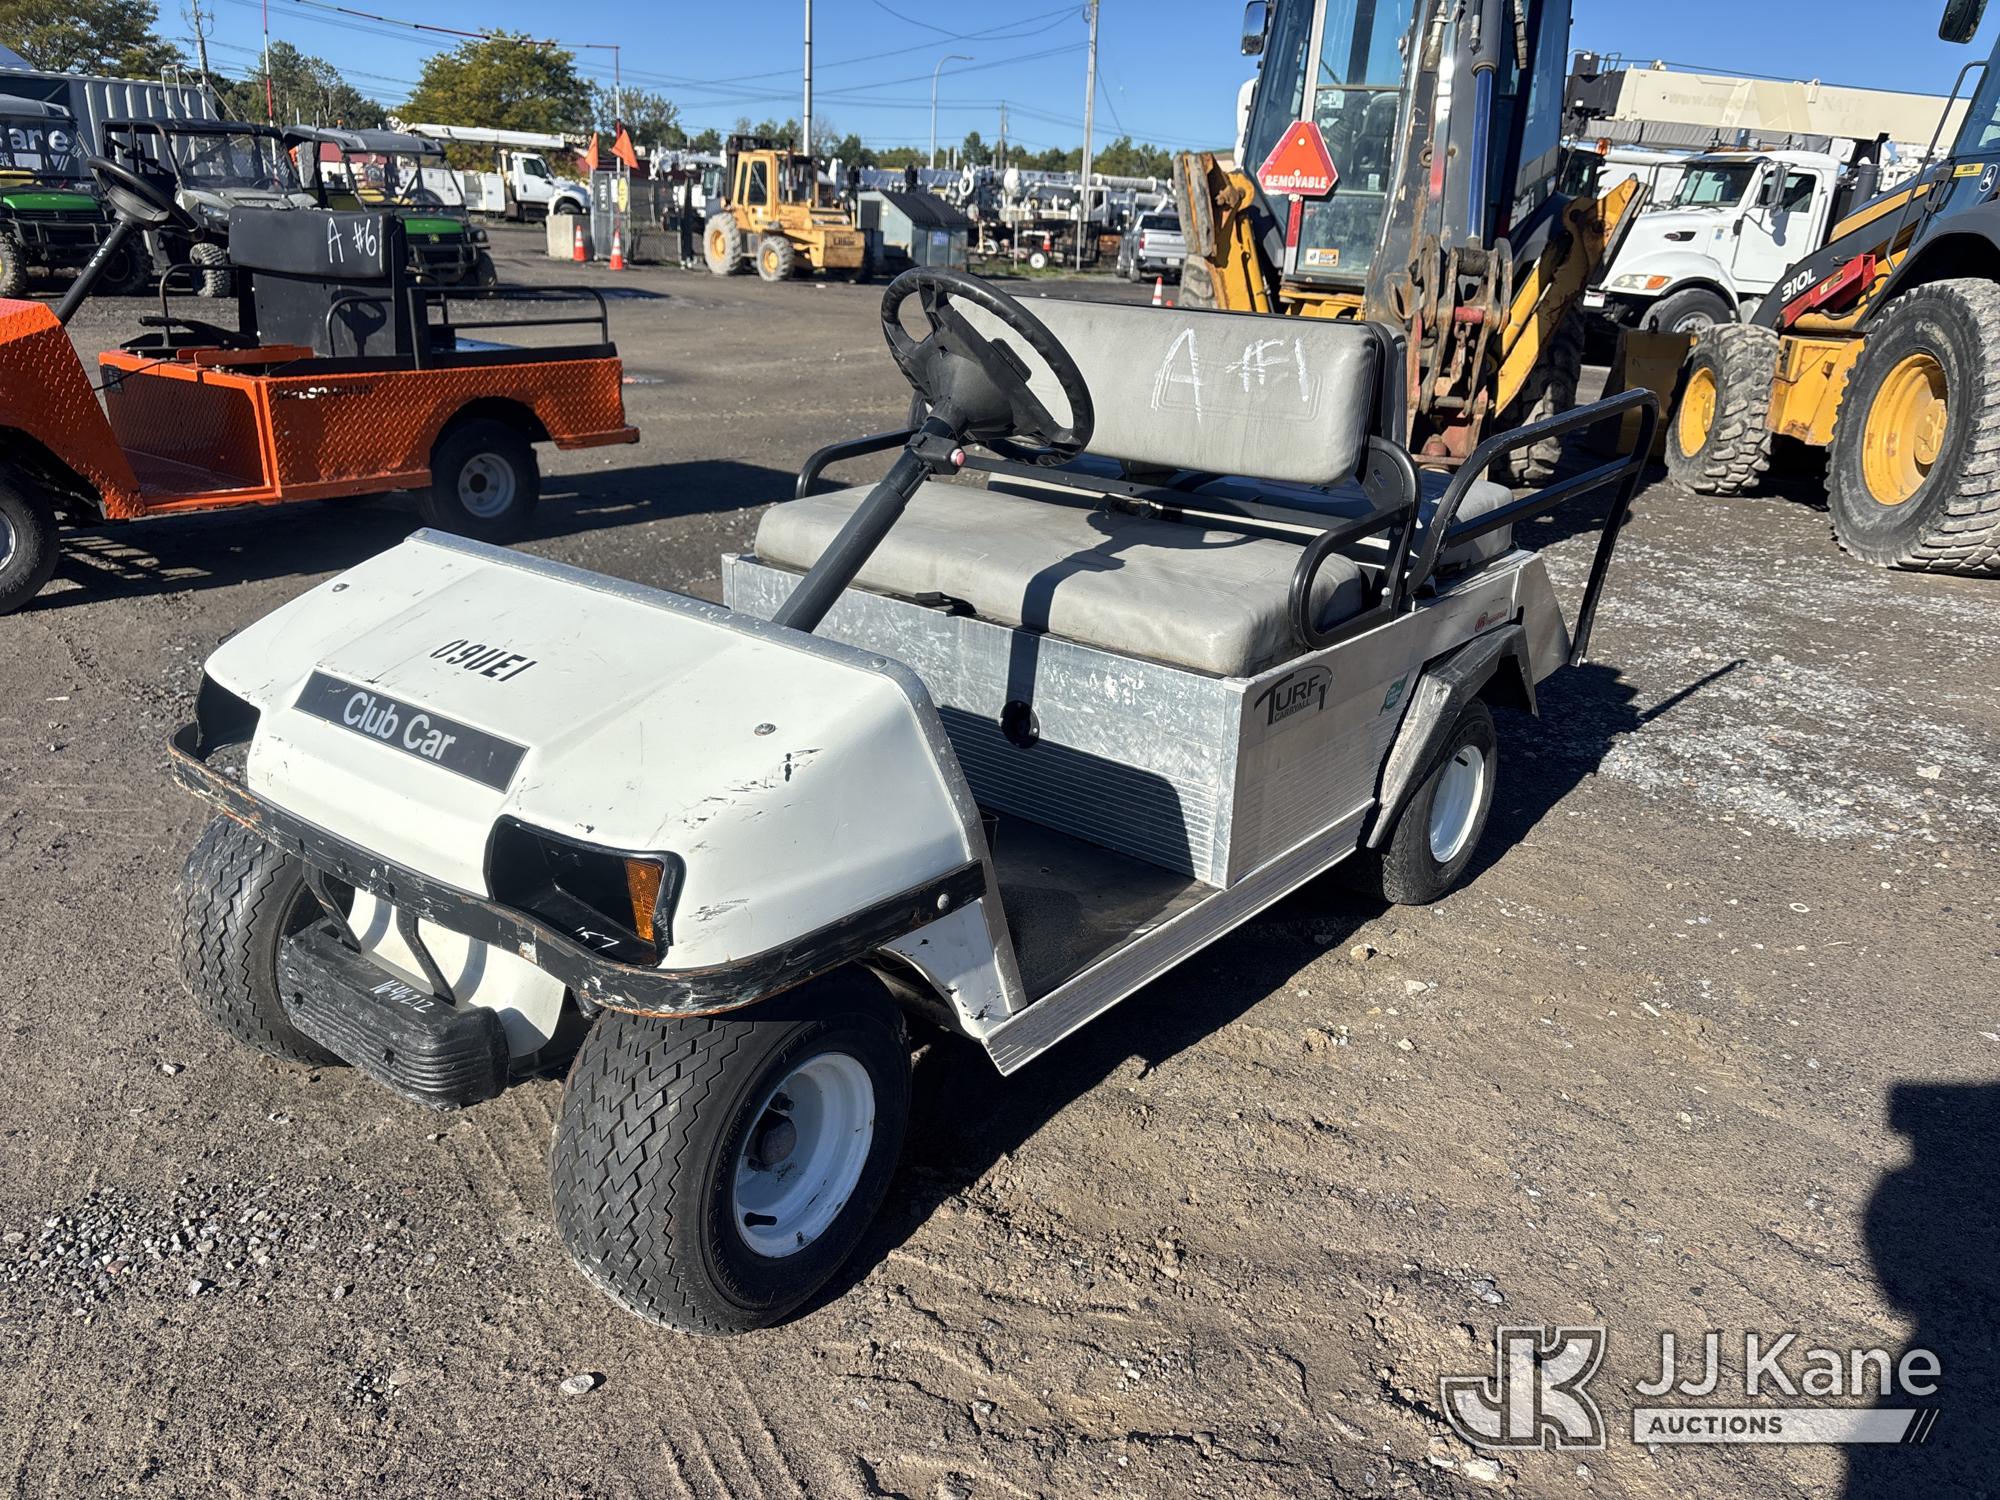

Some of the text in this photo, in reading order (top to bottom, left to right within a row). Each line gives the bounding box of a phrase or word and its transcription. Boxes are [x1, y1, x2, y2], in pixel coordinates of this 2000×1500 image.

[1264, 174, 1329, 189] REMOVABLE
[327, 216, 377, 264] A #6
[1781, 268, 1817, 302] 310L
[1150, 327, 1202, 424] A
[343, 691, 457, 761] Club Car
[369, 979, 435, 1014] 1646212
